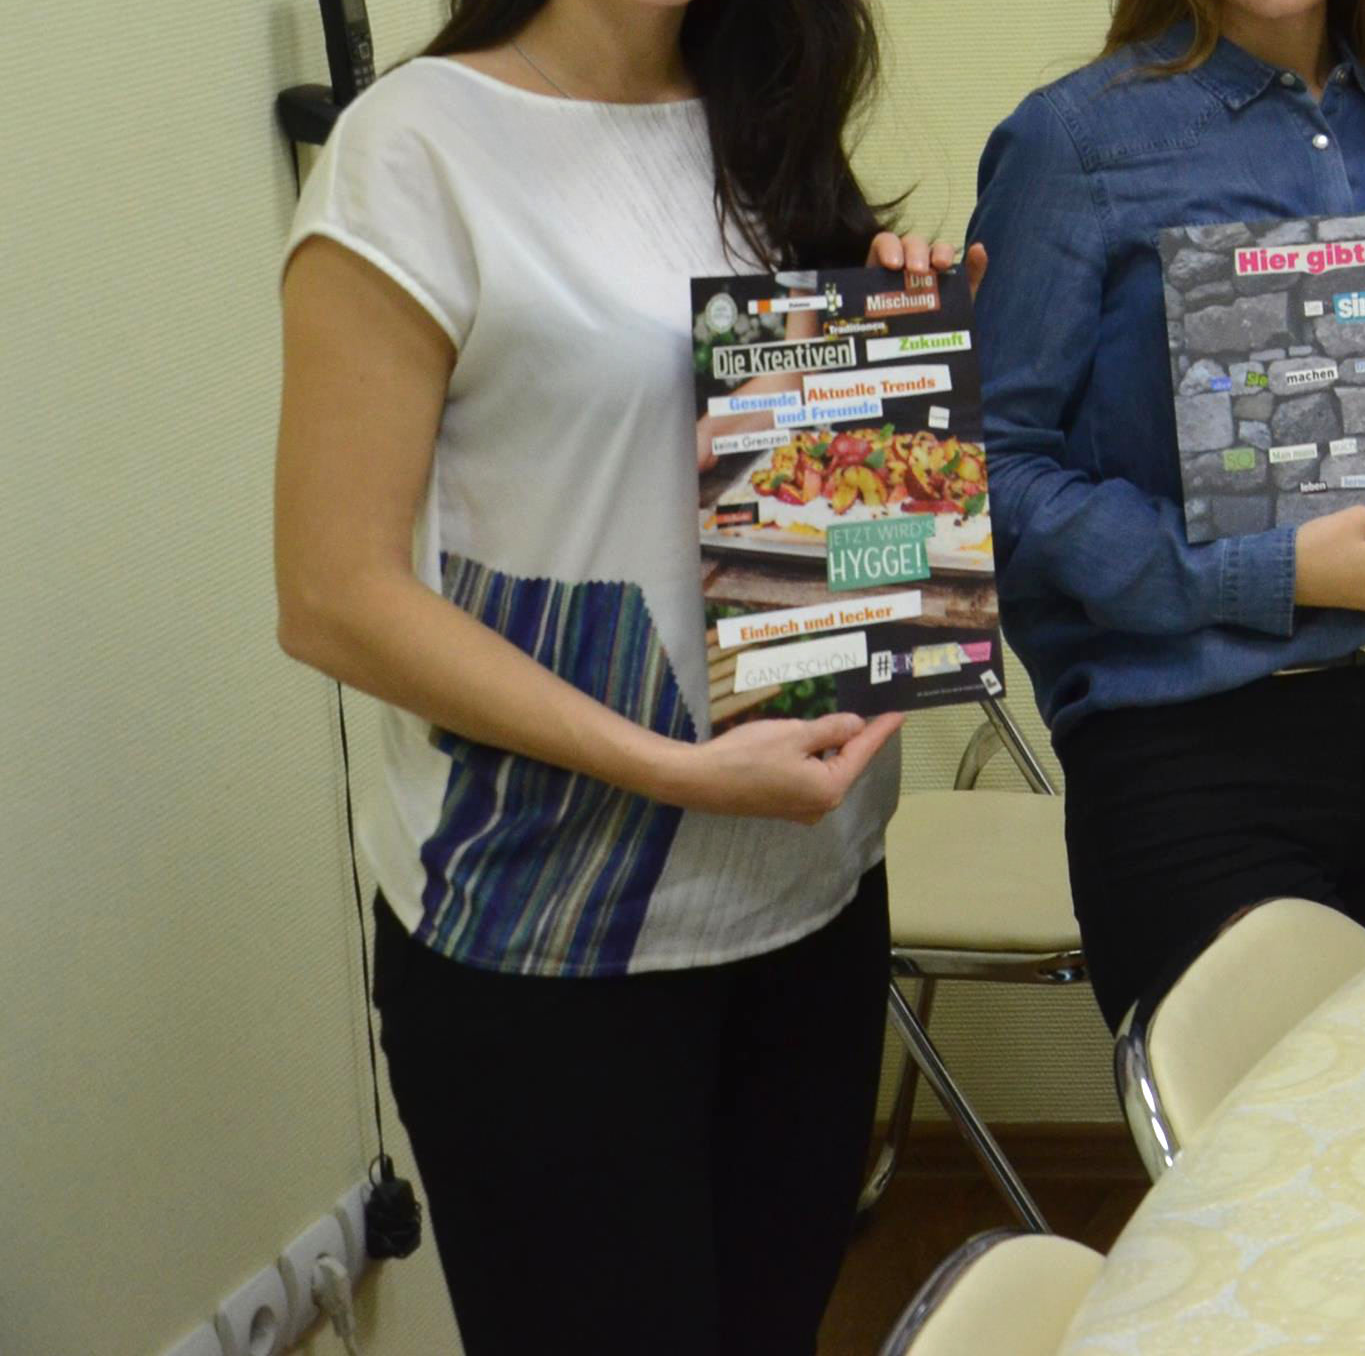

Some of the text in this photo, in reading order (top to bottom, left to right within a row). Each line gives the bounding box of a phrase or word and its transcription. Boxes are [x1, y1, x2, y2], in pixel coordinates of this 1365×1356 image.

[1238, 249, 1298, 273] Hier
[1306, 243, 1365, 275] gibt
[910, 275, 932, 287] Die
[866, 292, 935, 312] Mischung
[899, 333, 964, 352] Zukunft
[717, 342, 850, 375] Die Kreativen
[1286, 369, 1335, 384] machen
[807, 378, 936, 401] Aktuelle Trends
[729, 394, 798, 411] Gesunde
[777, 402, 879, 424] und Freunde
[742, 433, 788, 449] Grenzen
[1301, 481, 1326, 494] leben
[829, 521, 935, 547] JETZT WIRD'S
[829, 543, 922, 583] HYGGE!
[740, 607, 892, 641] Einfach und lecker
[745, 665, 790, 687] GANZ
